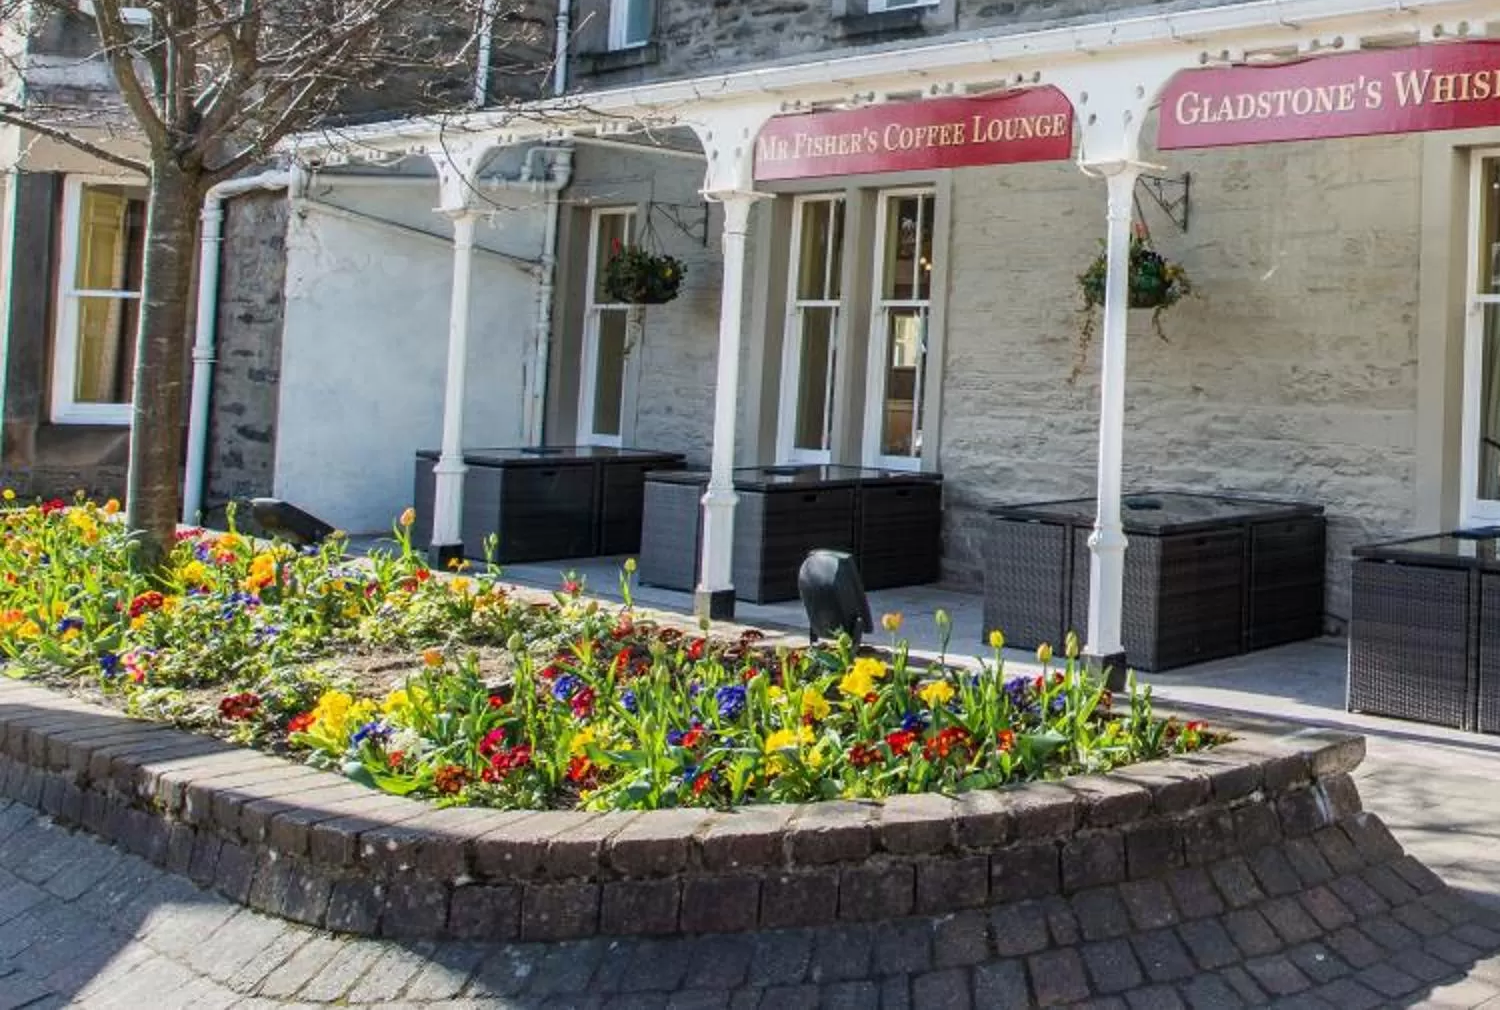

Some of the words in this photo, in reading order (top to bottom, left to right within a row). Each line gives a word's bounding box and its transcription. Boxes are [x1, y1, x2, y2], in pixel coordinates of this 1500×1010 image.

[1174, 75, 1383, 125] GLADSTONE'S
[794, 127, 879, 159] FISHER'S
[883, 121, 966, 151] COFFEE
[972, 113, 1067, 144] LOUNGE
